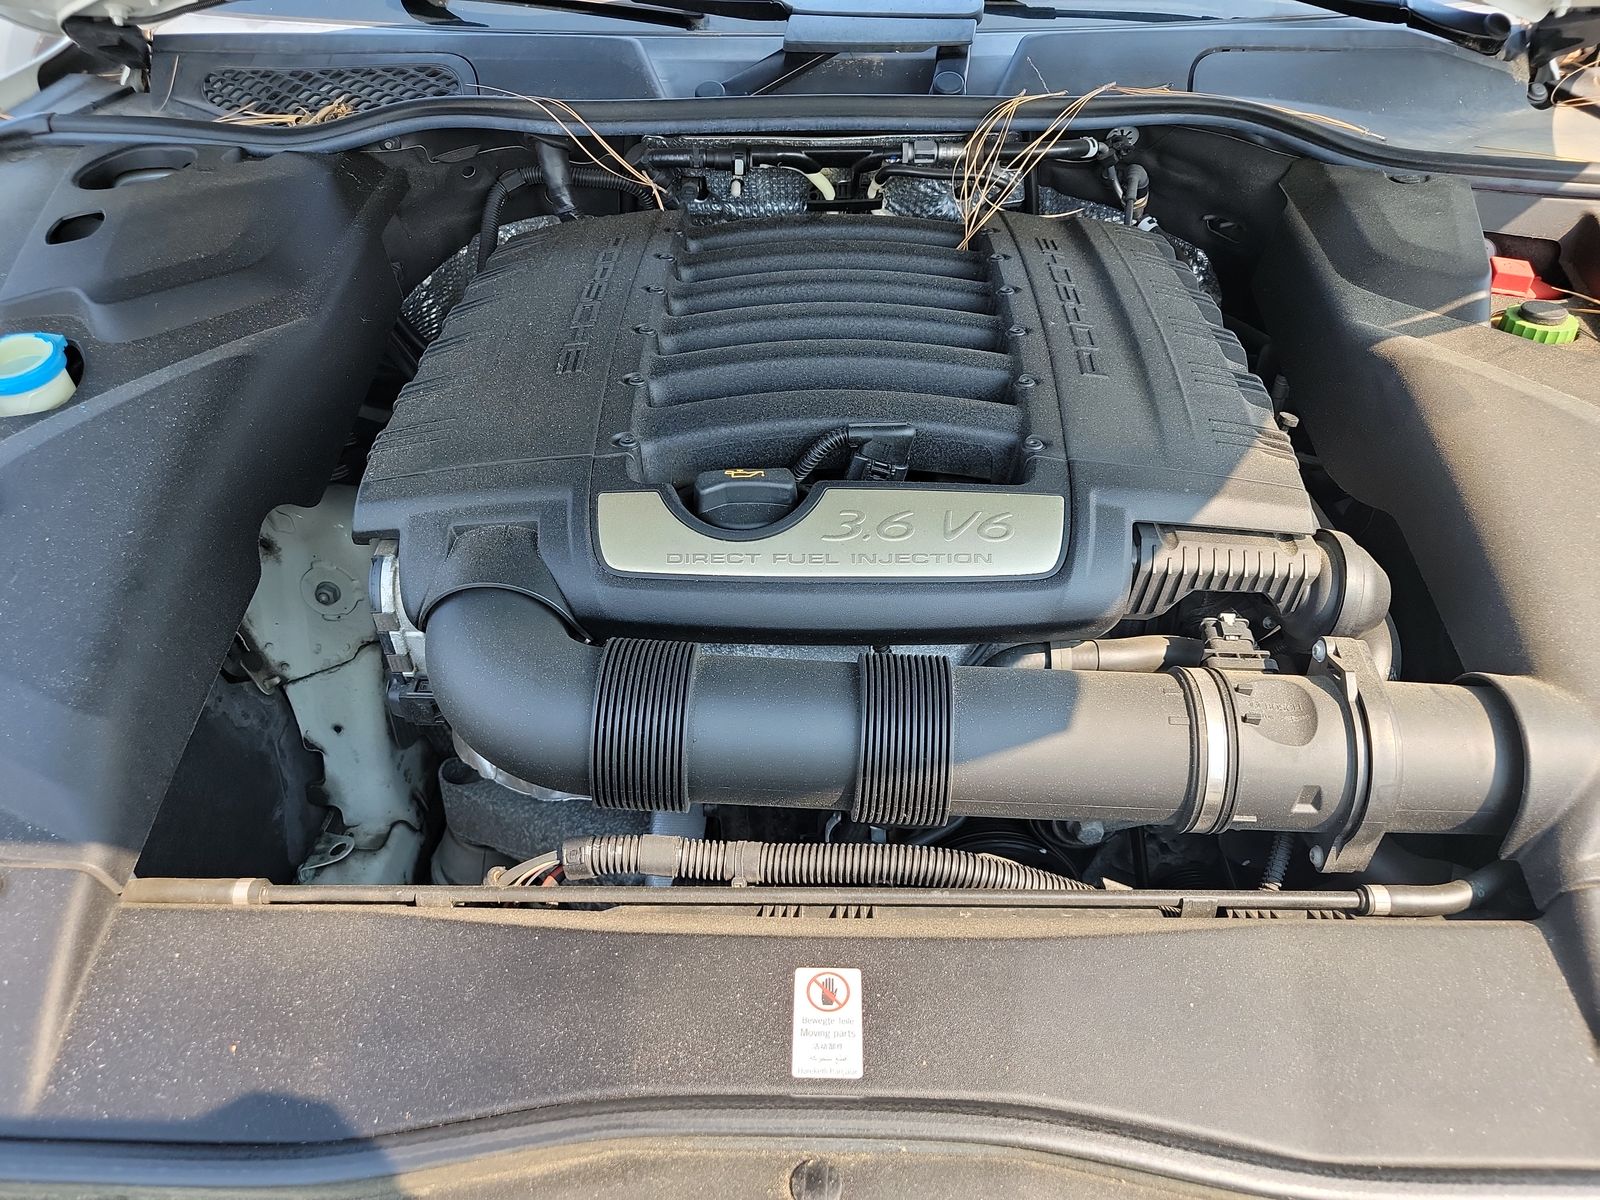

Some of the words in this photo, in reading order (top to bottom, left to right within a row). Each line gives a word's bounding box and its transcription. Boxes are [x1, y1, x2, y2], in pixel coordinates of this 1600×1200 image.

[1035, 237, 1110, 379] PORSCHE
[821, 509, 916, 543] 3.6
[943, 509, 1016, 543] V6
[665, 552, 760, 566] DIRECT
[772, 552, 840, 566] FUEL
[850, 552, 994, 566] INJECTION
[800, 1028, 831, 1039] Moving
[833, 1029, 856, 1039] parts
